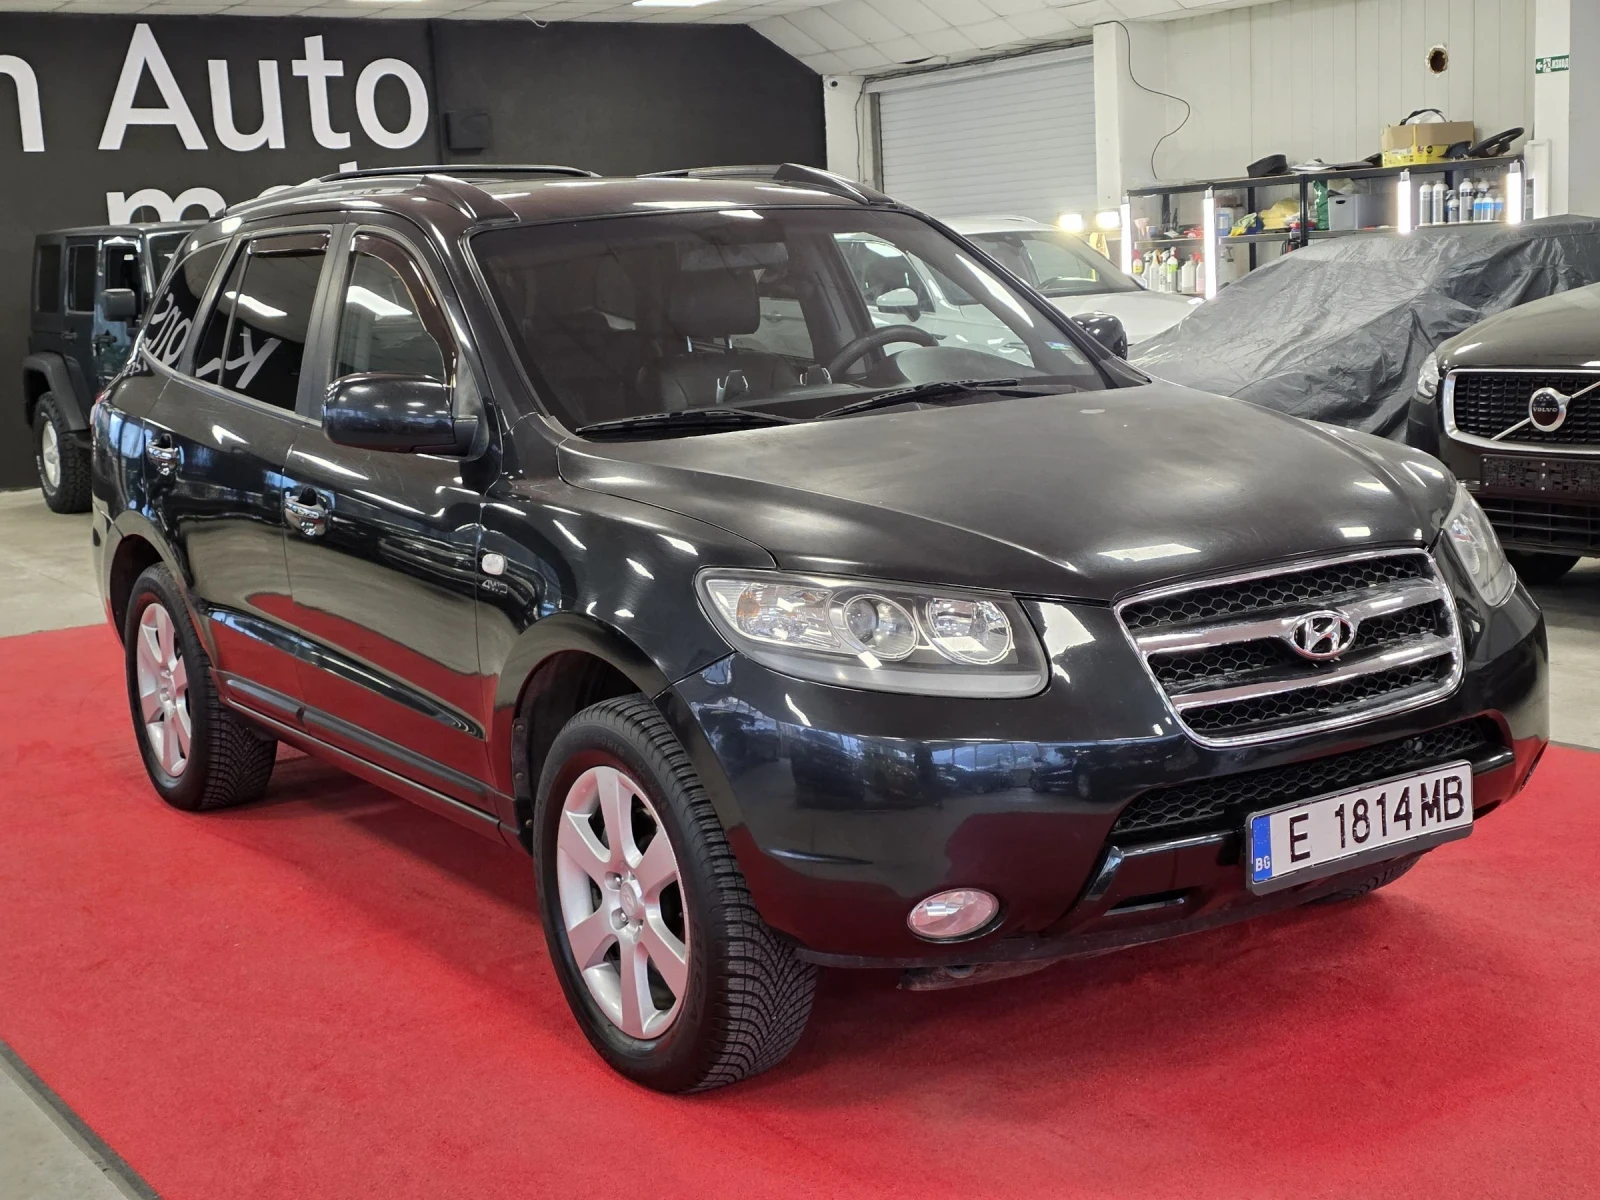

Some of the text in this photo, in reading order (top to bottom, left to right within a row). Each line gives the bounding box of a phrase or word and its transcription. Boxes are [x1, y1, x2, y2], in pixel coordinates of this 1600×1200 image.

[98, 23, 429, 151] Auto
[481, 579, 508, 594] 4WD
[1289, 812, 1311, 864] E
[1255, 854, 1271, 872] BG
